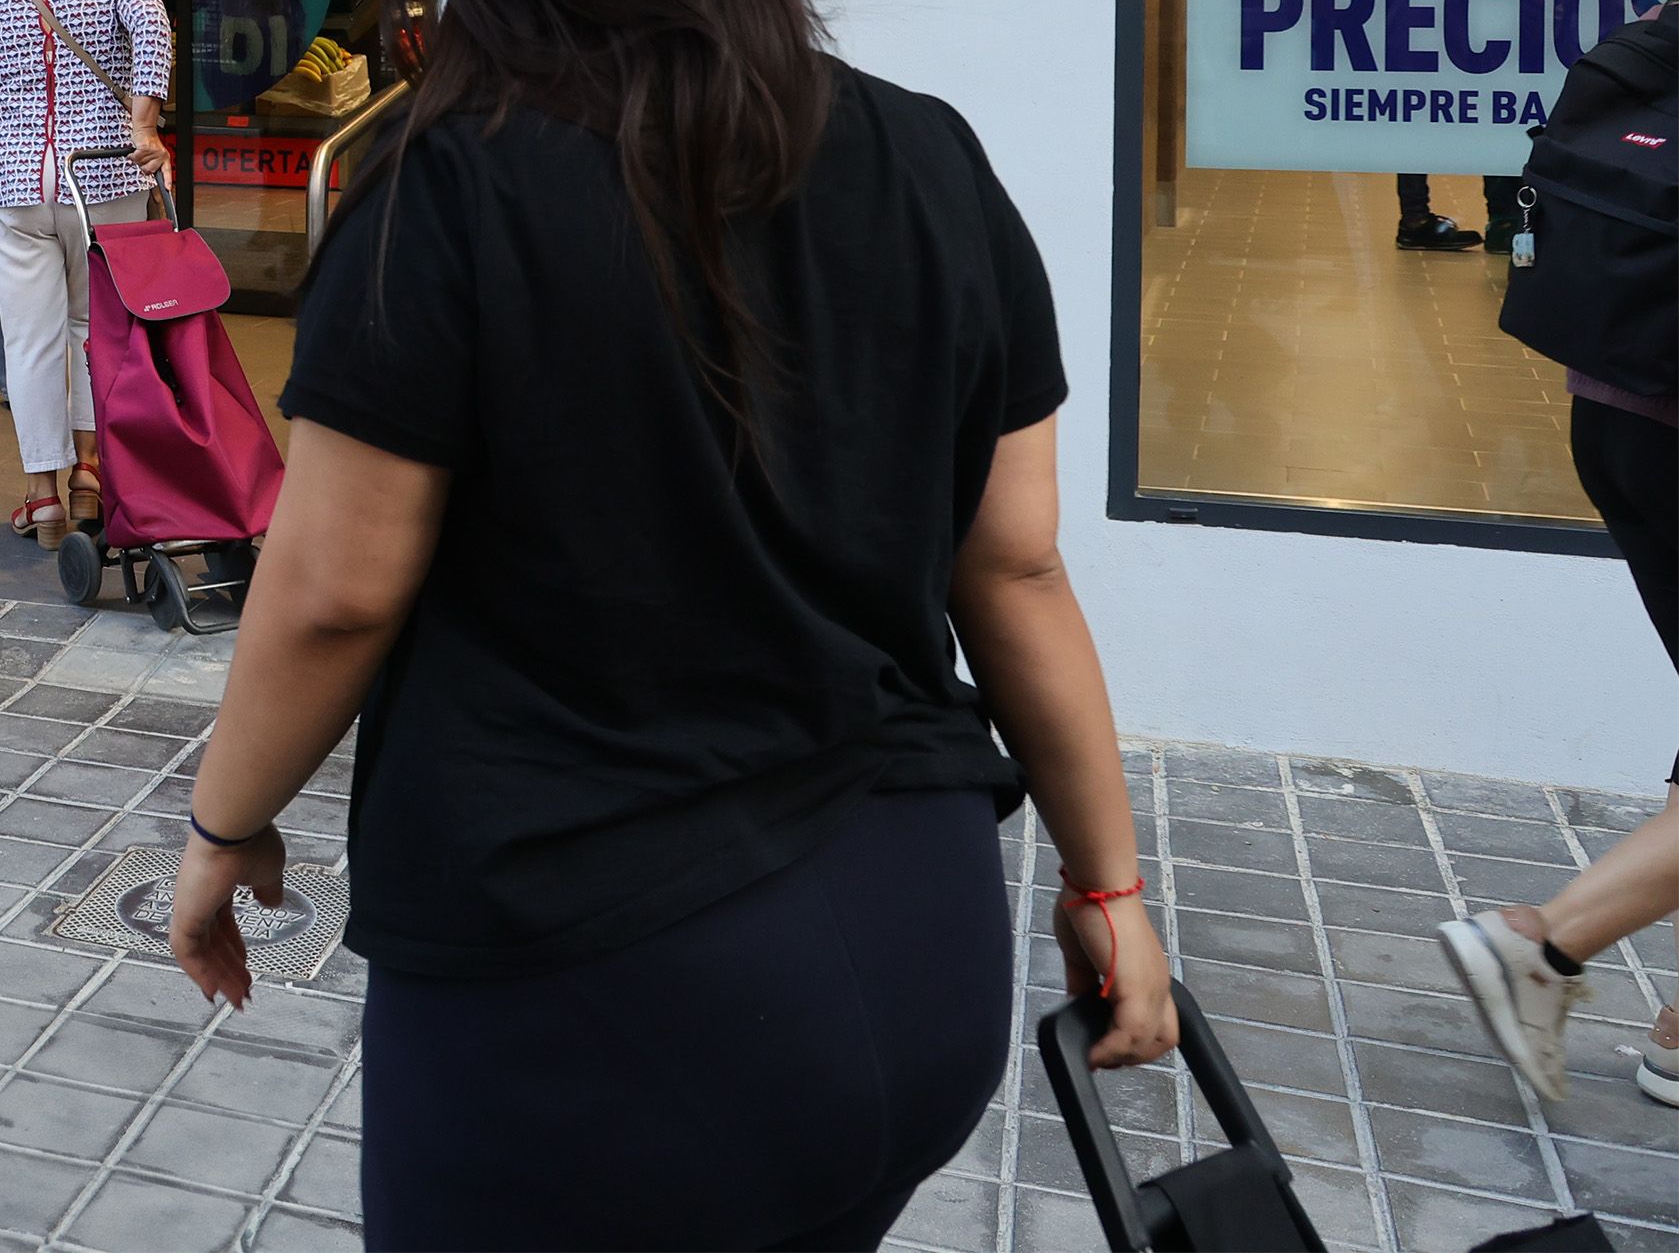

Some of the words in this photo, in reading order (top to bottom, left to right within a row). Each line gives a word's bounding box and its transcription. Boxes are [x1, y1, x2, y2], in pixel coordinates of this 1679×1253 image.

[1304, 88, 1479, 124] SIEMPRE
[131, 908, 168, 923] DE
[243, 905, 307, 921] 2007
